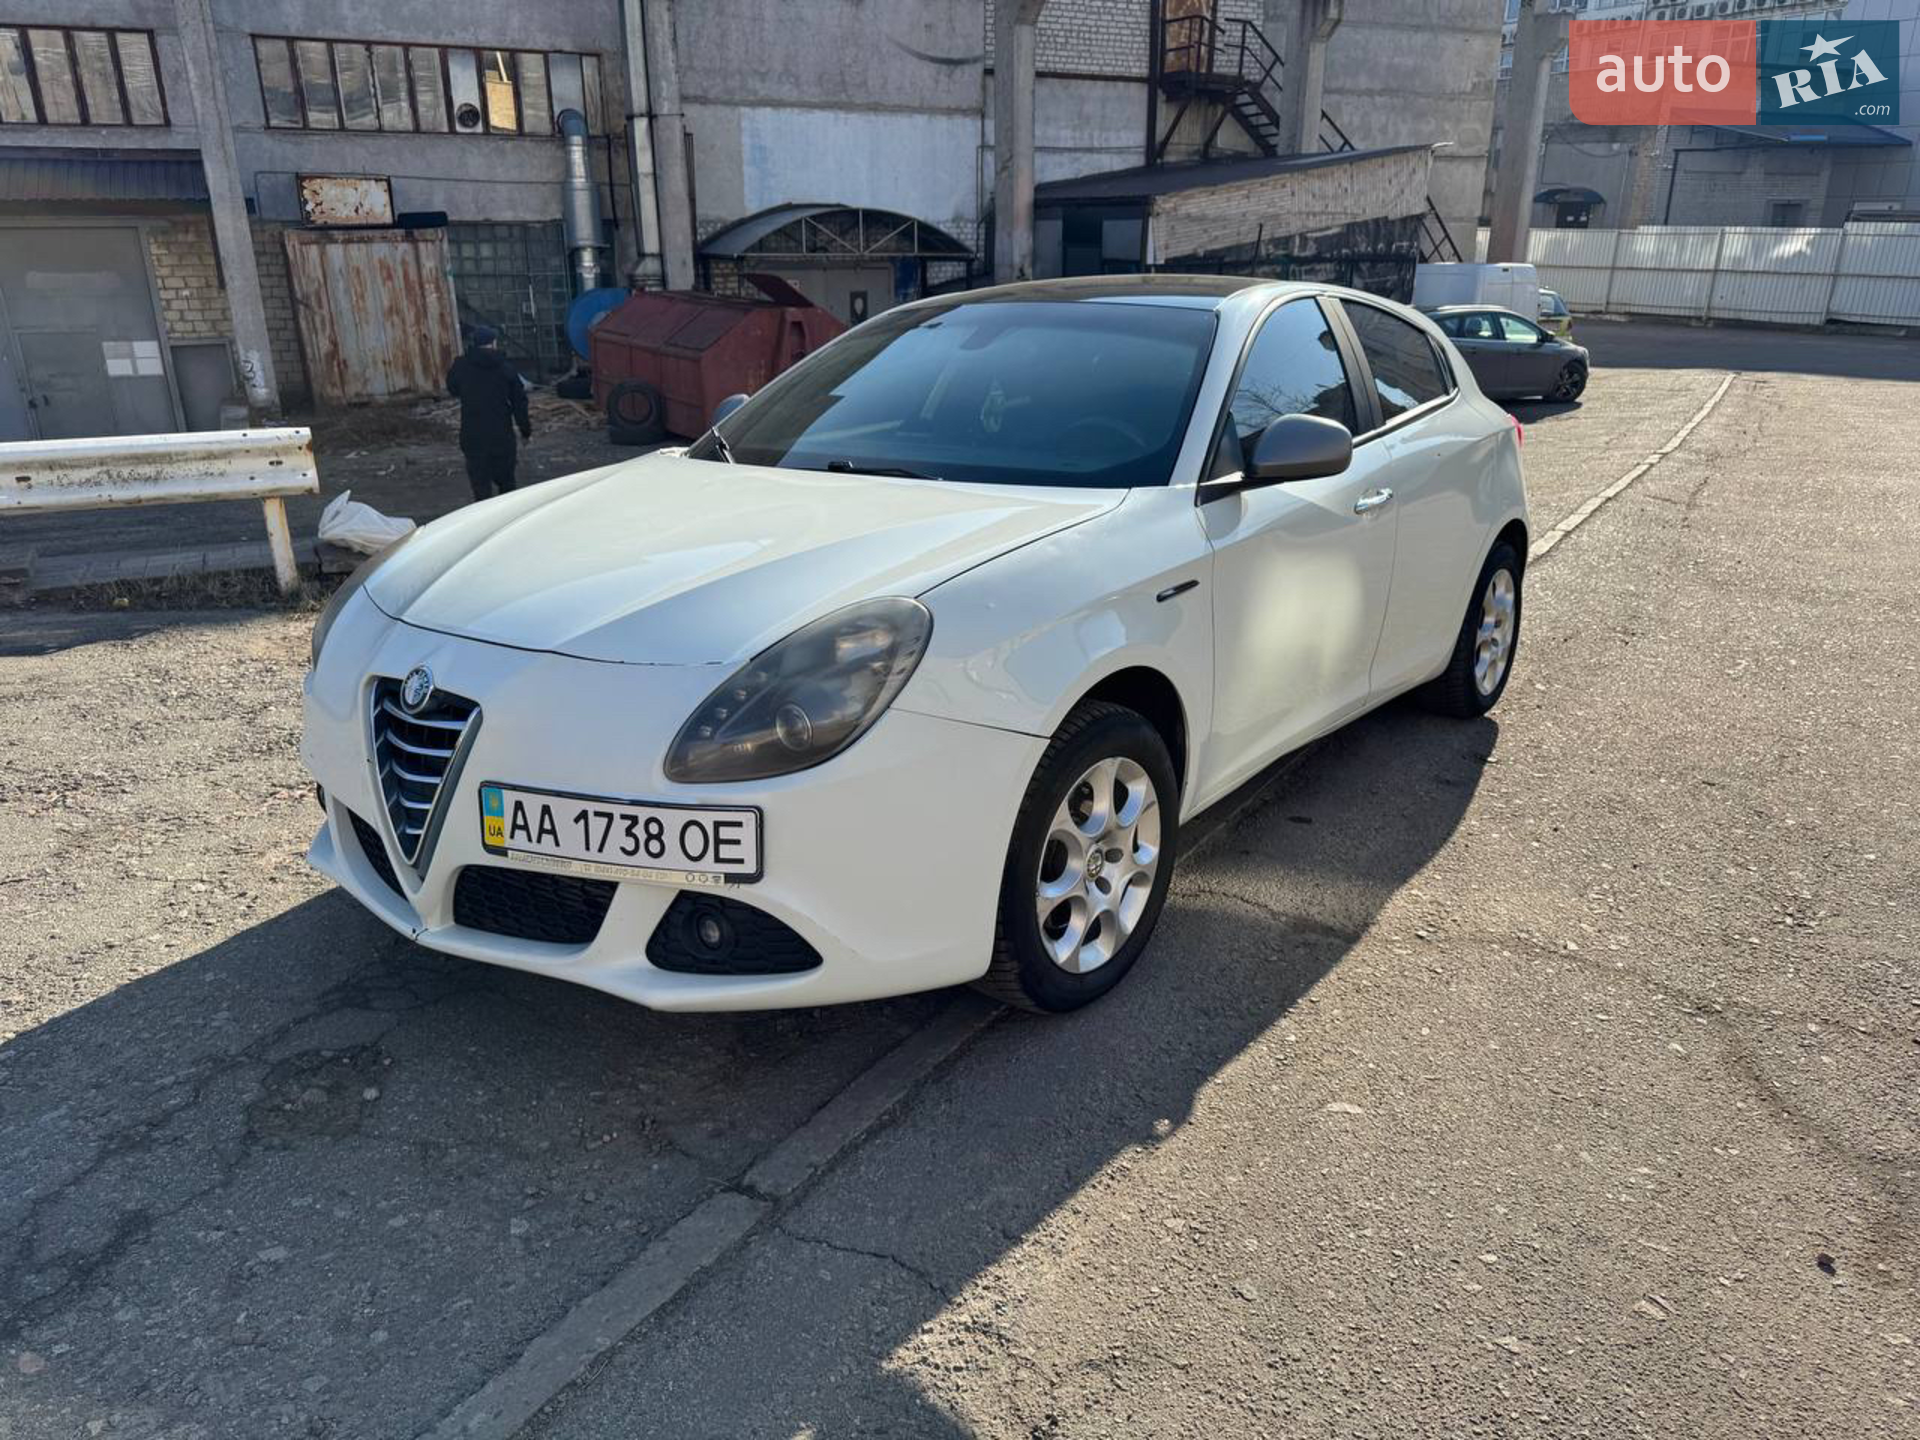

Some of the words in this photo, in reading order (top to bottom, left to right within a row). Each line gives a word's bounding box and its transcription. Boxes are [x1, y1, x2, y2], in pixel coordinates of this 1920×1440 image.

[488, 824, 505, 838] UA
[509, 800, 561, 848] AA
[573, 809, 666, 859] 1738
[679, 819, 745, 864] OE
